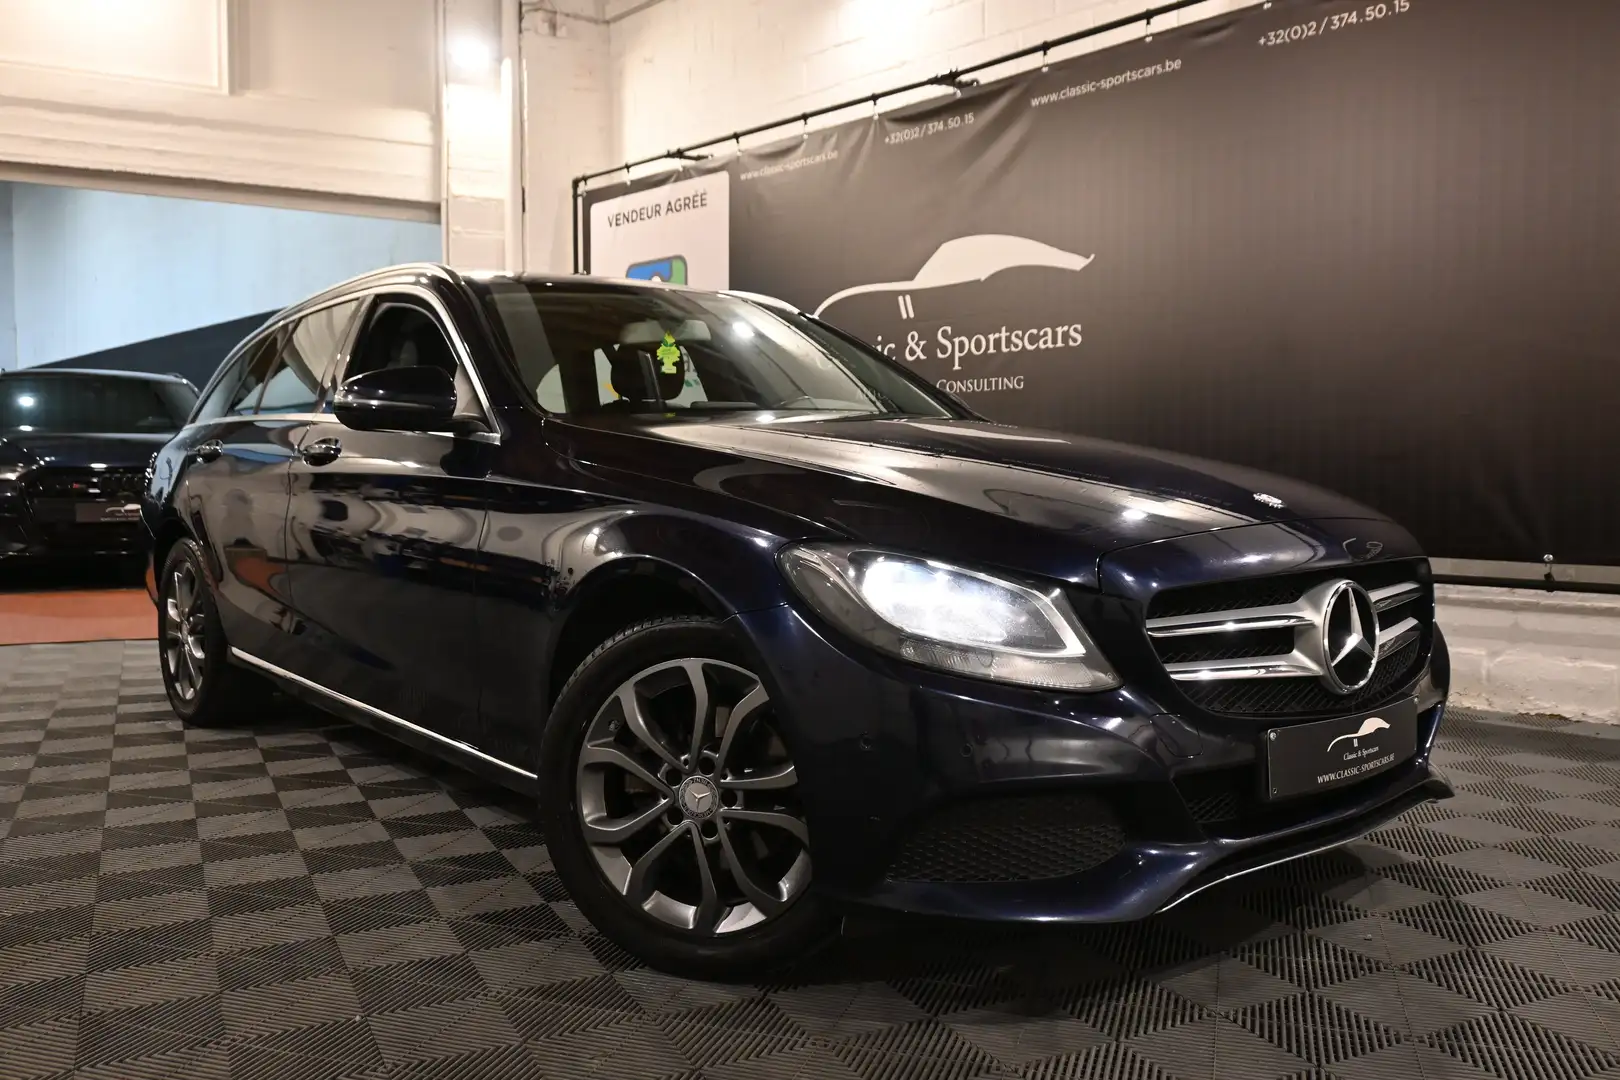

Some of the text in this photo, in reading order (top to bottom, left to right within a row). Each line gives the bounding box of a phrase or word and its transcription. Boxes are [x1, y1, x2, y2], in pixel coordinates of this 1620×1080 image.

[1030, 58, 1182, 107] www.classic-sportscars.be
[607, 188, 708, 228] VENDEUR AGRÉÉ
[904, 330, 928, 361] &
[936, 323, 1083, 371] Sportscars
[1317, 752, 1395, 784] WWW.CLASSIC-SPORTSCARS.BE
